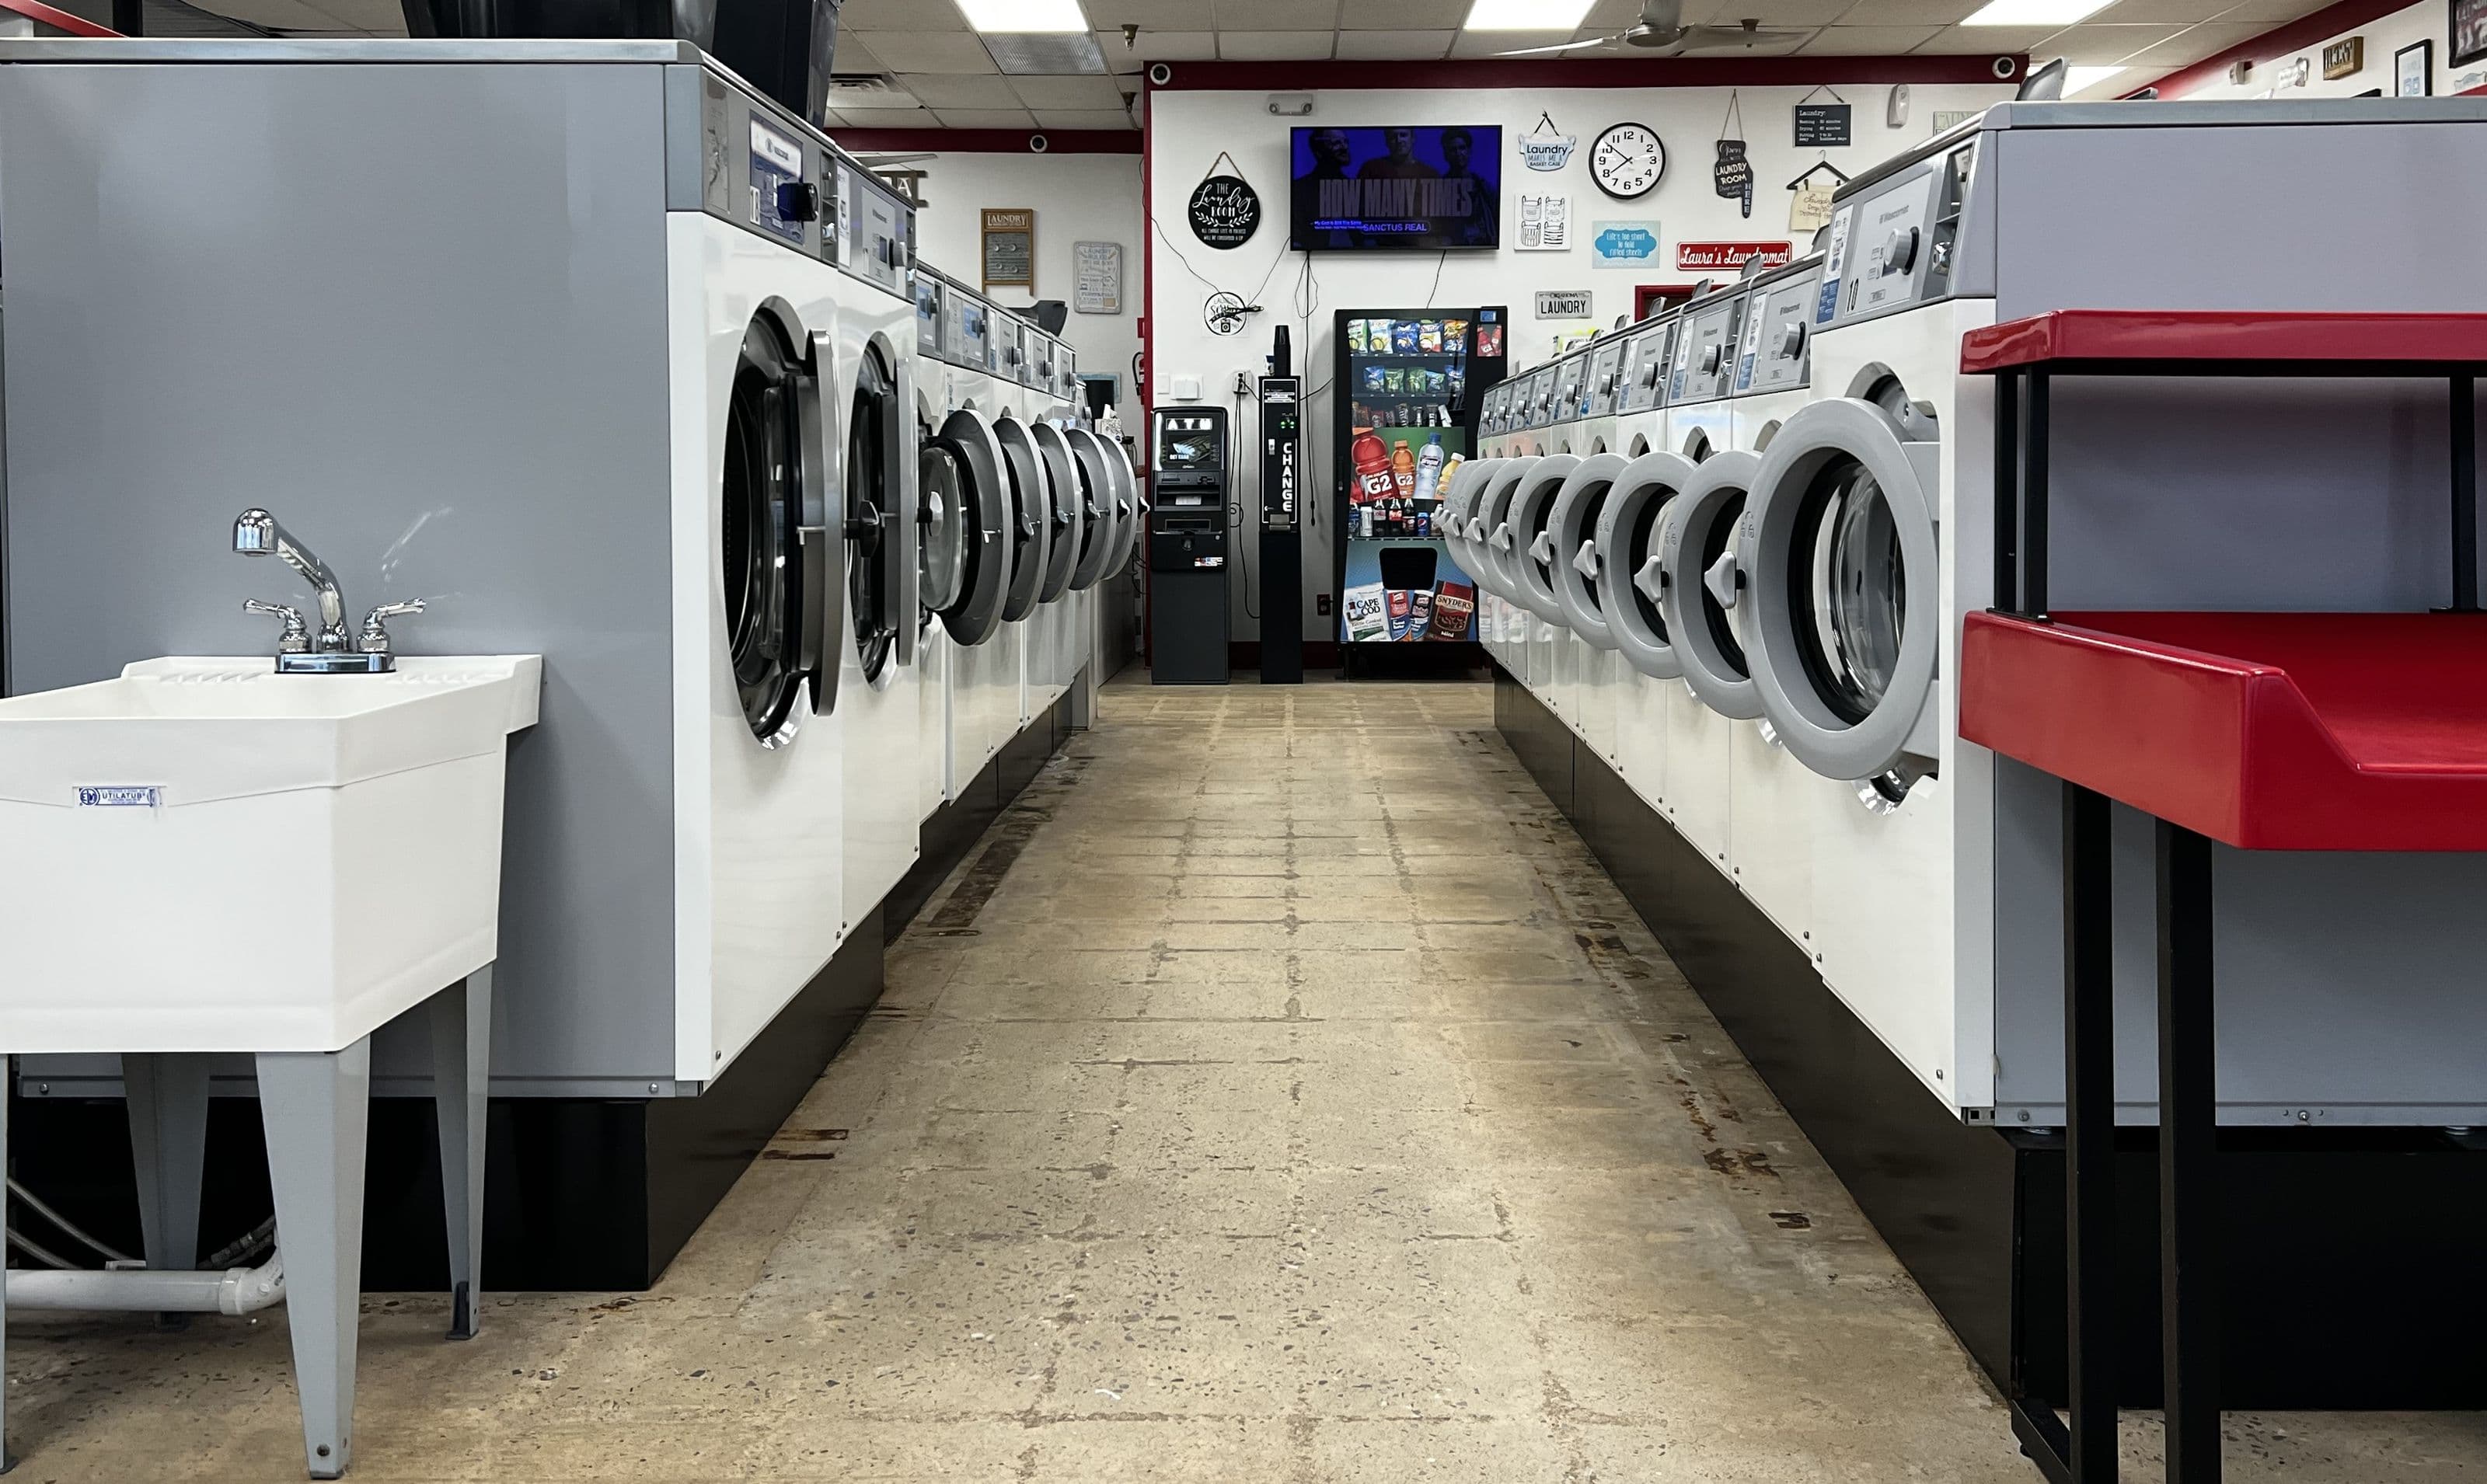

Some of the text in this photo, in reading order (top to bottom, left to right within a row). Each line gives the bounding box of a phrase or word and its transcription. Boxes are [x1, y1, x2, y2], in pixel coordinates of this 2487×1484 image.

[1613, 134, 1620, 143] 11
[1624, 131, 1634, 140] 12
[1641, 134, 1644, 143] 1
[1526, 145, 1568, 155] Laundry
[1646, 144, 1654, 152] 2
[1599, 156, 1606, 165] 9
[1649, 156, 1657, 165] 3
[1603, 169, 1610, 178] 8
[1645, 169, 1652, 177] 4
[1715, 162, 1747, 176] LAUNDRY
[1612, 178, 1619, 186] 7
[1635, 177, 1643, 186] 5
[1720, 174, 1747, 185] ROOM
[1216, 183, 1229, 194] THE
[1624, 181, 1631, 190] 6
[1192, 184, 1255, 214] Laundry
[1320, 179, 1474, 218] HOW MANY TIMES
[1211, 206, 1236, 217] ROOM
[987, 214, 1026, 226] LAUNDRY
[1363, 223, 1403, 232] SANCTUS
[1404, 223, 1427, 232] REAL
[1680, 246, 1721, 264] Laura's
[1847, 278, 1858, 312] 10
[1540, 300, 1585, 314] LAUNDRY
[1167, 418, 1211, 430] ATM
[1282, 442, 1292, 512] CHANGE
[1398, 475, 1414, 486] G2
[1367, 474, 1393, 495] G2
[1356, 597, 1380, 608] CAPE
[1361, 607, 1380, 616] COD
